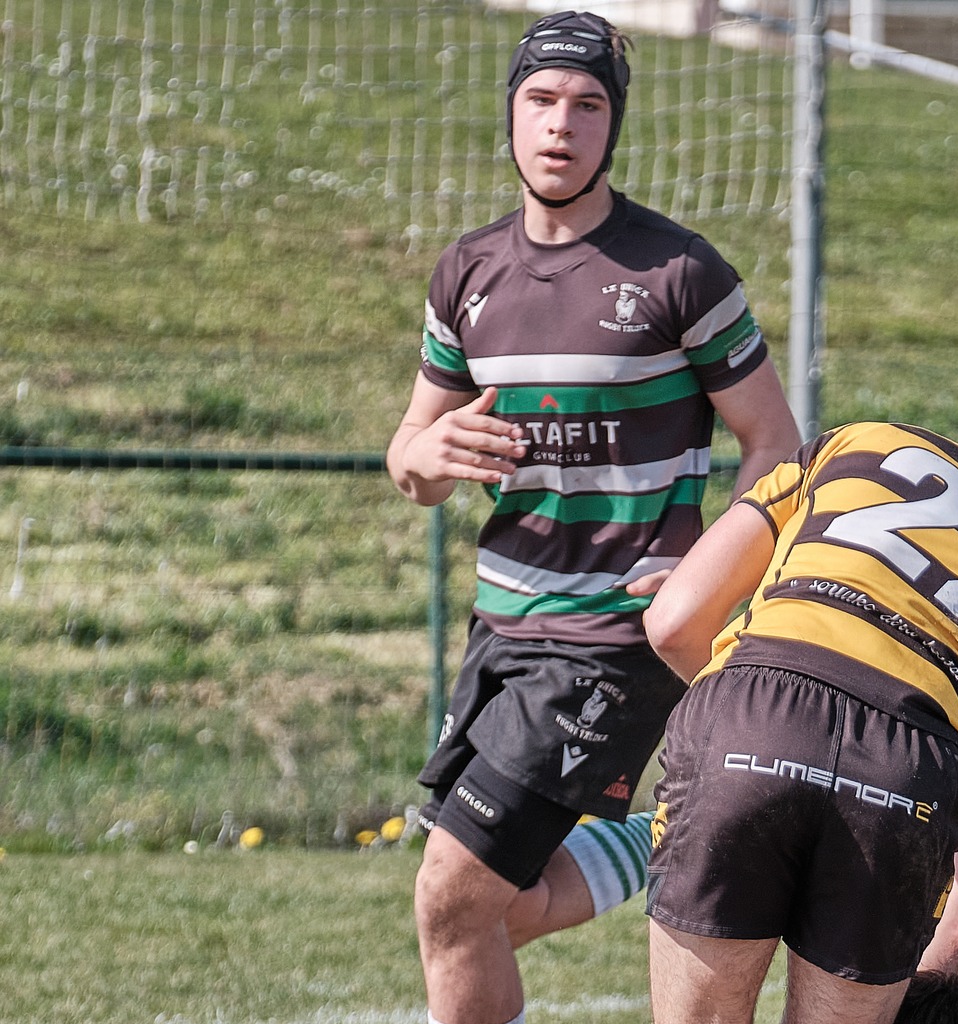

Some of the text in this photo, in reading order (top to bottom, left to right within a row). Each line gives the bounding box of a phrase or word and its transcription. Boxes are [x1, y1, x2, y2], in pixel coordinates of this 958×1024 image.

[541, 42, 588, 54] OFFLOAD
[500, 420, 621, 447] LTAFIT
[457, 786, 495, 818] OFFLOAD
